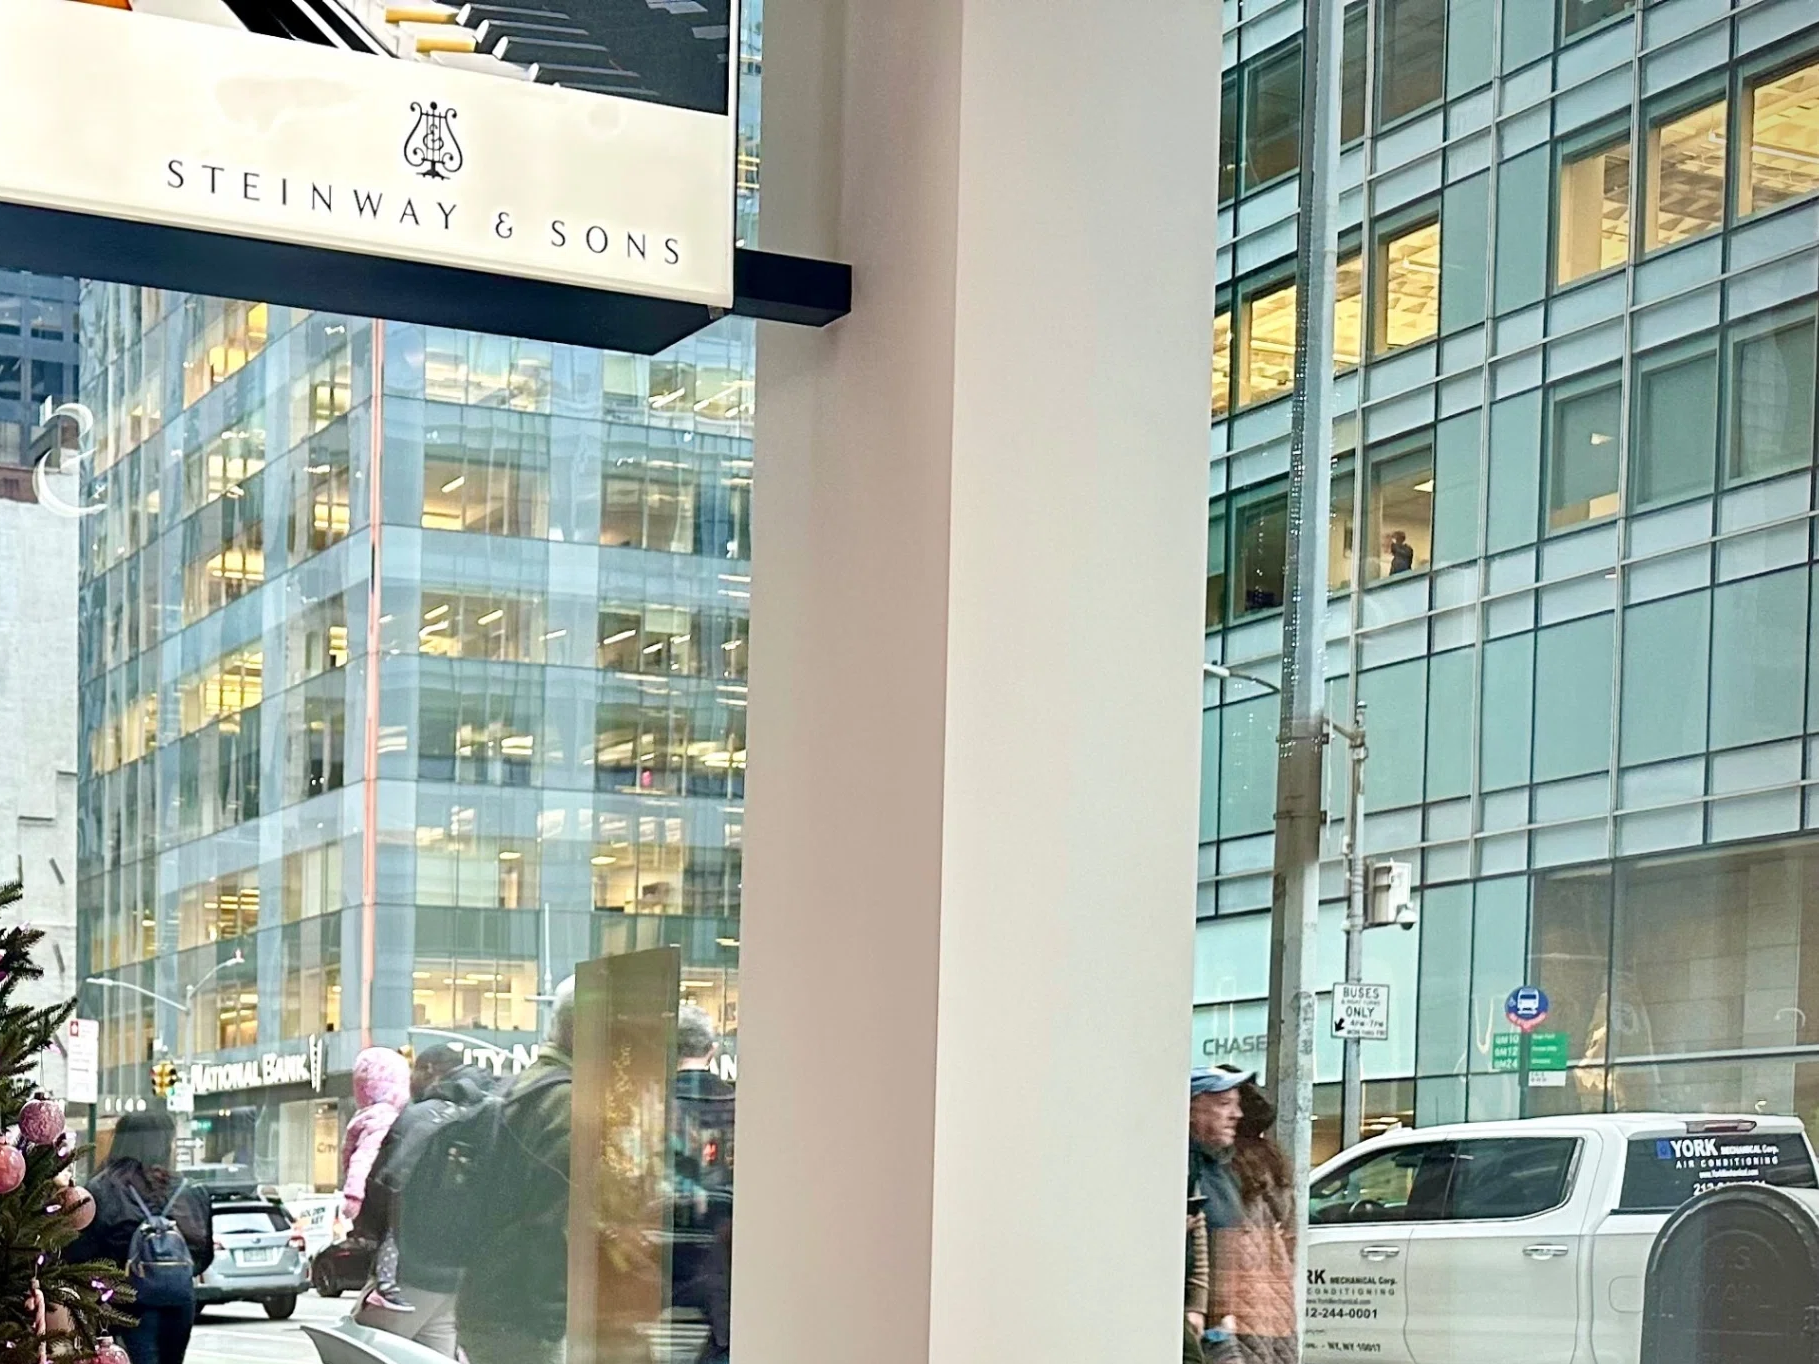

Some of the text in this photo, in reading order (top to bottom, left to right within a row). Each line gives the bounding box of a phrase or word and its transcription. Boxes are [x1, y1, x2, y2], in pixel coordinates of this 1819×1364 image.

[166, 158, 682, 267] STEINWAY & SONS
[1343, 986, 1380, 1000] BUSES
[1345, 1005, 1375, 1018] ONLY
[1202, 1034, 1268, 1056] CHASE
[447, 1041, 508, 1077] ITY
[191, 1051, 311, 1096] NATIONAL BANK
[1670, 1138, 1719, 1158] YORK
[1675, 1156, 1779, 1170] AIR CONDITIONING
[1306, 1268, 1326, 1284] RK
[1305, 1306, 1378, 1319] 12-244-0001
